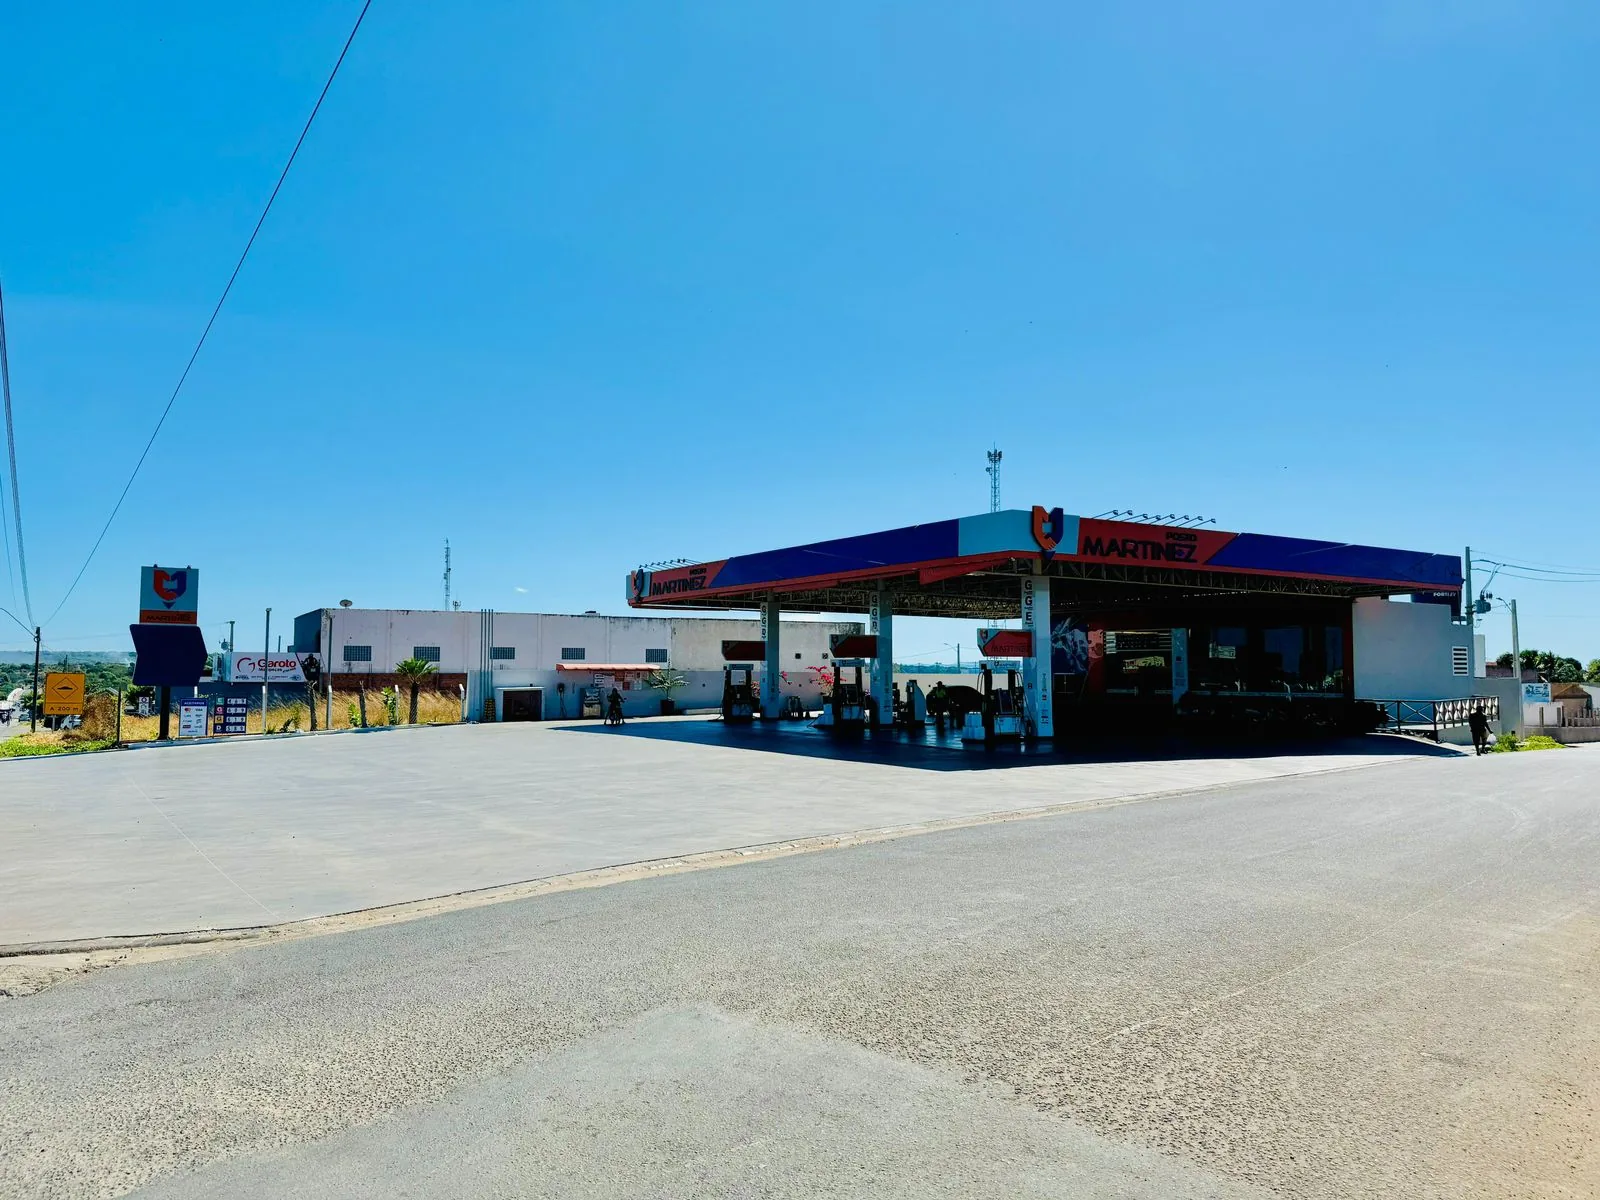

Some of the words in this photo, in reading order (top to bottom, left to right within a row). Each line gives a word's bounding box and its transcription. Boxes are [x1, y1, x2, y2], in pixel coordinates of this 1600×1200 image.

[1165, 532, 1198, 542] POSTO
[1083, 536, 1198, 562] MARTINEZ
[653, 576, 707, 596] MARTINEZ
[258, 659, 297, 668] Garoto
